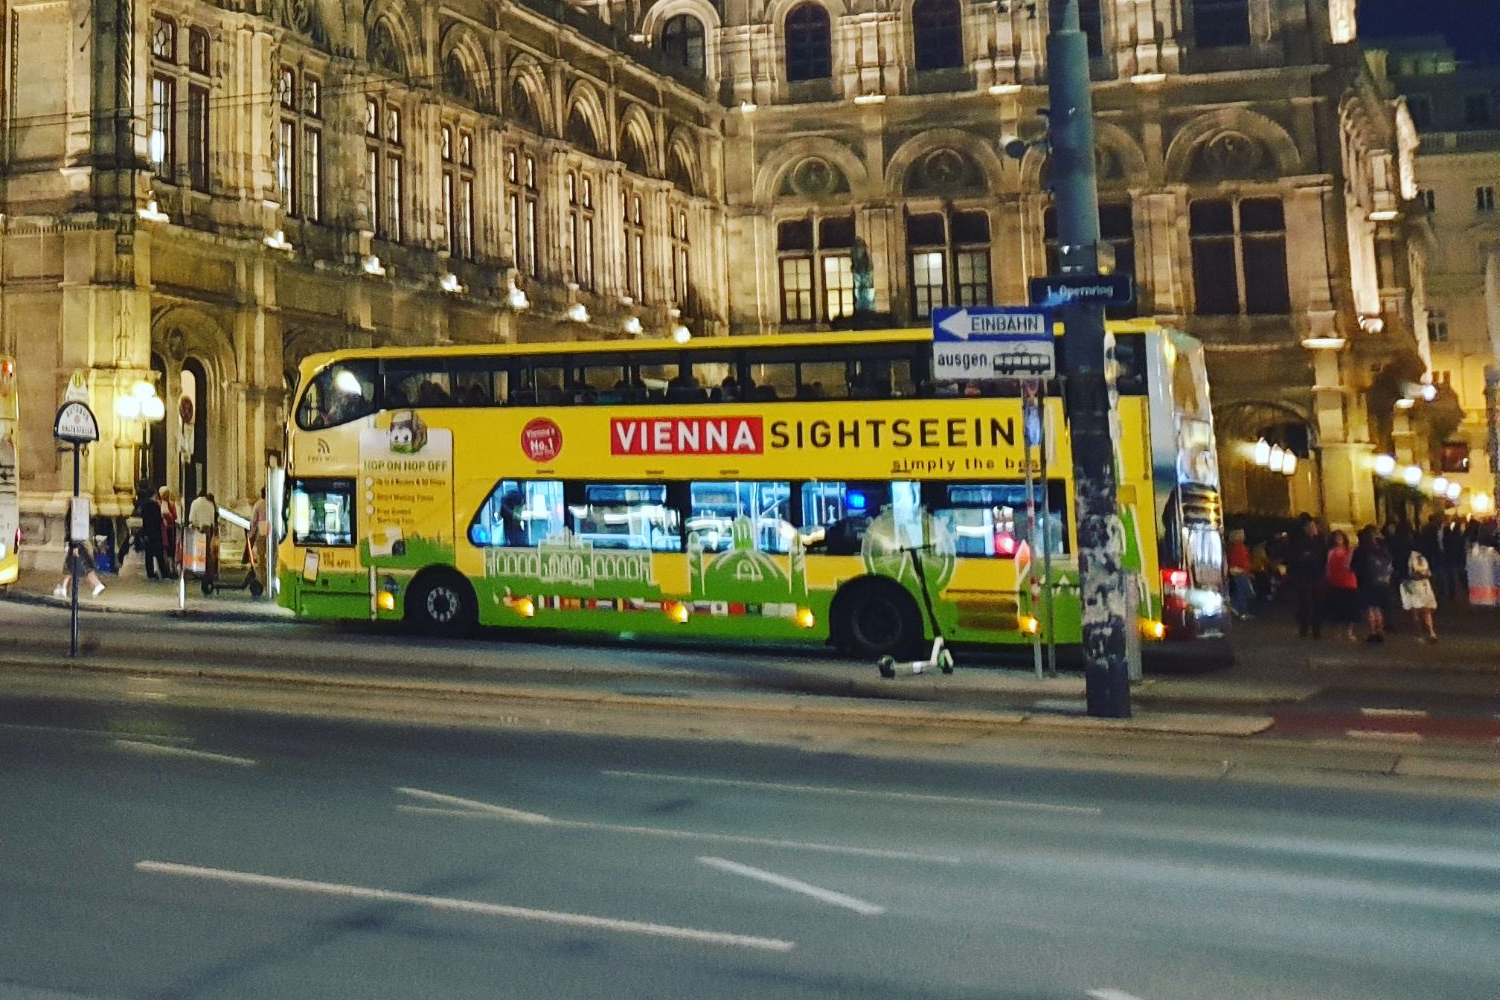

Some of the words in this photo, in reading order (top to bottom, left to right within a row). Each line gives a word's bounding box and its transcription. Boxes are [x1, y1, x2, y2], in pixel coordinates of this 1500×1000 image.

[1060, 285, 1114, 301] Opernring
[971, 315, 1039, 332] EINBAHN
[616, 420, 757, 452] VIENNA
[770, 418, 1015, 449] SIGHTSEEIN
[364, 460, 385, 471] HOP
[387, 460, 401, 471] ON
[404, 460, 425, 472] HOP
[428, 460, 448, 472] OFF
[892, 457, 955, 473] simply
[965, 457, 995, 470] the
[1005, 456, 1040, 471] bes
